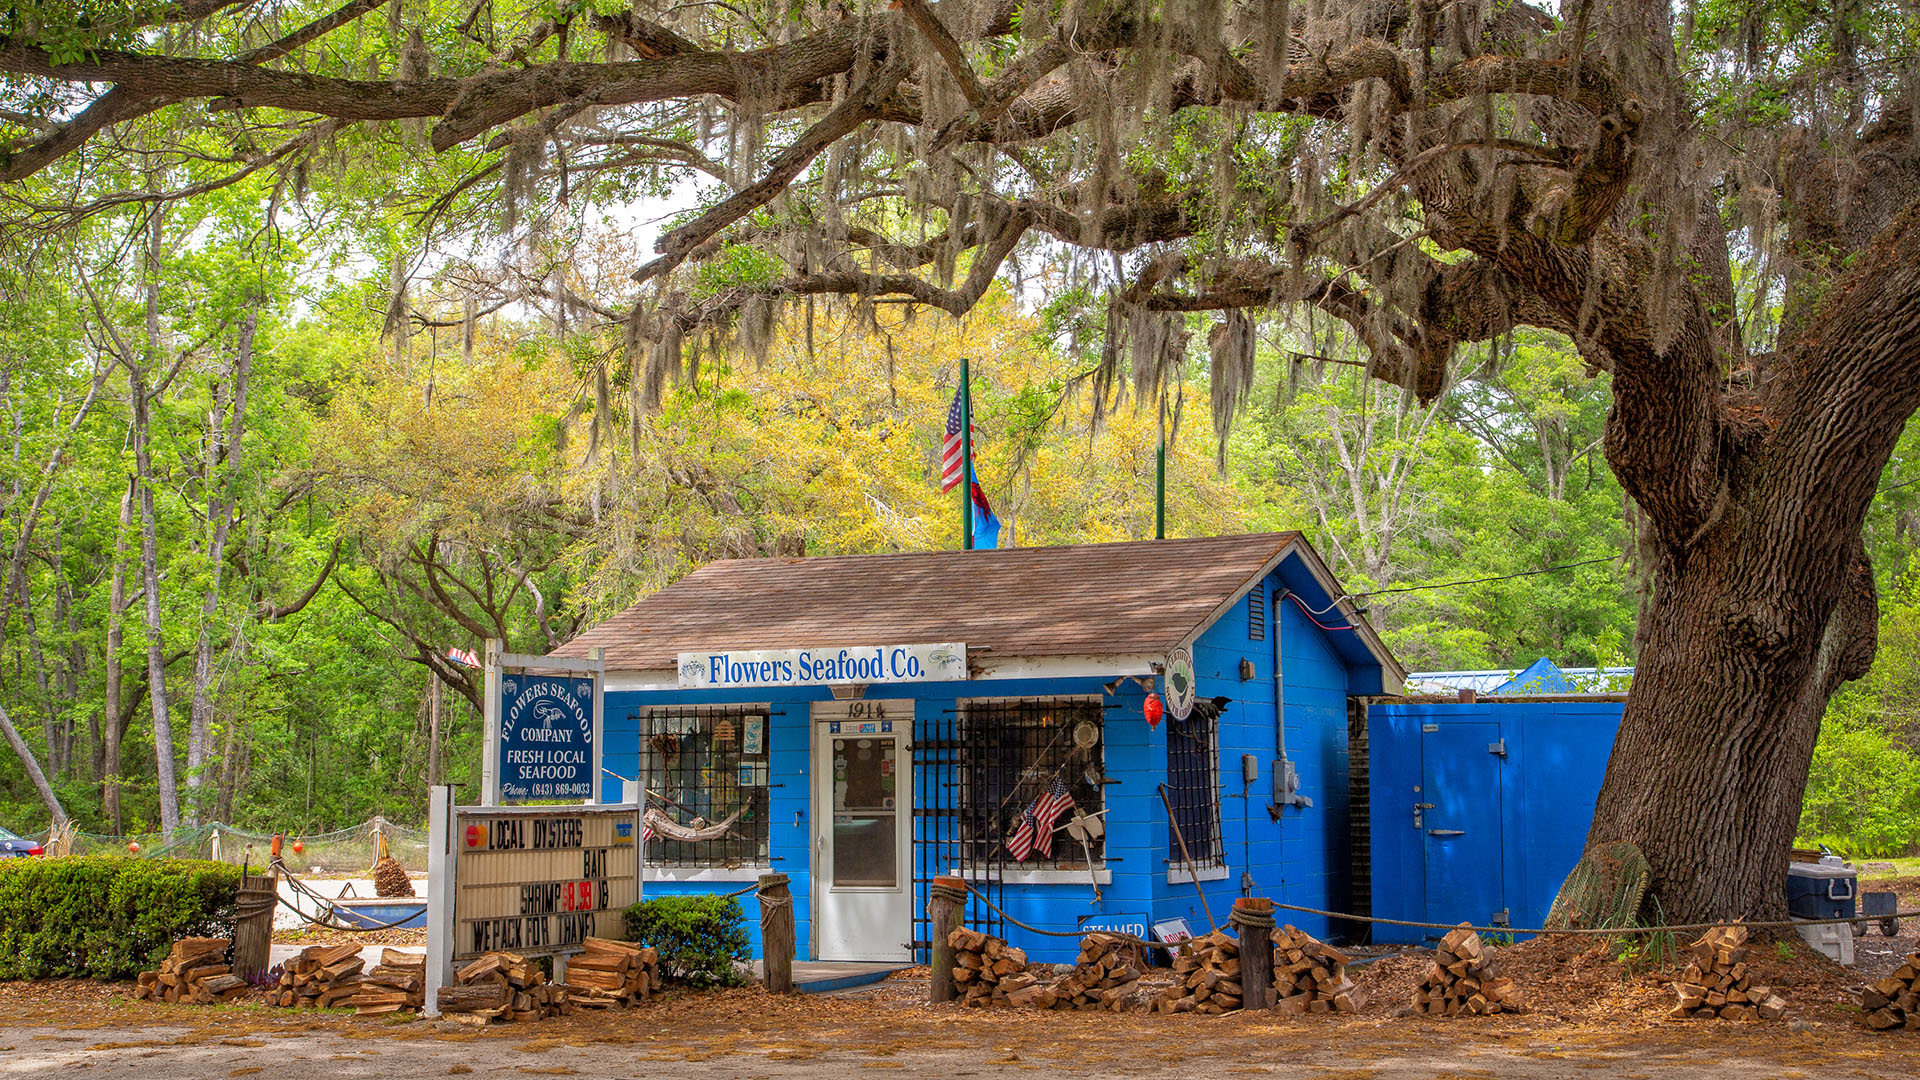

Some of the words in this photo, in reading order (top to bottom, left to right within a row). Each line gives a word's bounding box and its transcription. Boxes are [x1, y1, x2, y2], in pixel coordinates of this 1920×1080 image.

[708, 654, 792, 683] Flowers
[799, 649, 884, 681] Seafood
[890, 648, 925, 678] Co.
[501, 682, 548, 743] FLOWERS
[550, 682, 592, 744] SEAFOOD
[521, 727, 573, 742] COMPANY
[507, 750, 544, 763] FRESH
[547, 750, 586, 763] LOCAL
[519, 765, 576, 779] SEAFOOD
[532, 783, 552, 795] (843)
[555, 783, 590, 795] 869-0033
[489, 820, 525, 850] LOCAL
[534, 819, 583, 848] OYSTERS
[584, 850, 607, 878] BAIT
[521, 883, 561, 914] SHRIMP
[526, 916, 549, 946] FOR
